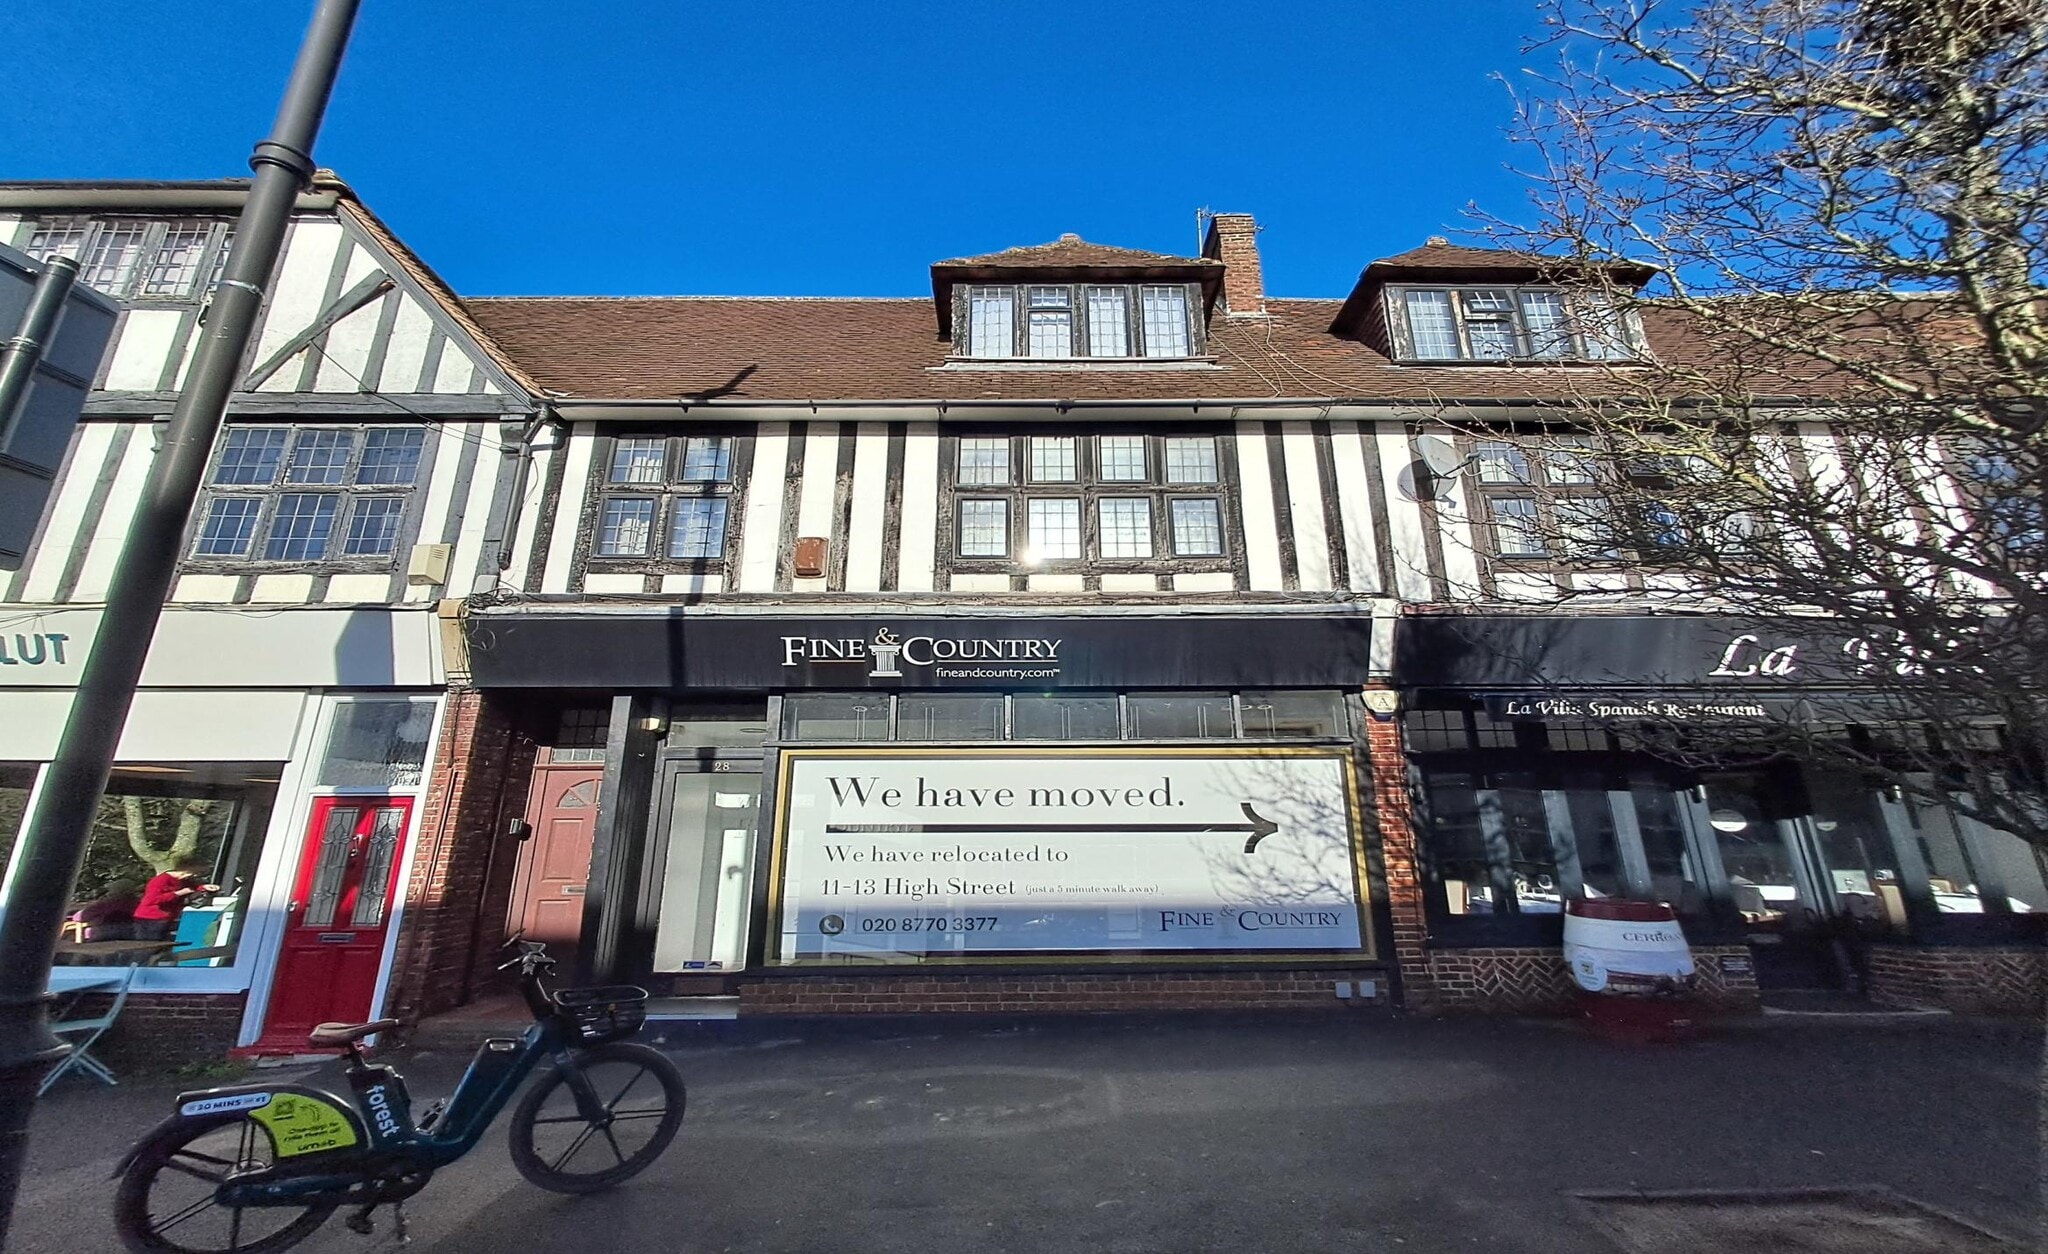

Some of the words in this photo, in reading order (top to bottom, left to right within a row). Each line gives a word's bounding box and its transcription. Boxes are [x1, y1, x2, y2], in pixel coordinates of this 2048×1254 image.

[780, 636, 866, 666] FINE
[874, 627, 899, 645] &
[902, 636, 1062, 666] COUNTRY
[1708, 634, 1798, 676] La
[1506, 701, 1531, 715] La
[714, 762, 730, 772] 28
[825, 776, 902, 808] We
[914, 776, 1015, 808] have
[1027, 776, 1186, 808] moved.
[824, 844, 865, 863] We
[871, 844, 925, 863] have
[931, 844, 1041, 863] relocated
[1046, 846, 1070, 863] to
[821, 878, 877, 896] 11-13
[883, 877, 940, 902] High
[946, 877, 1017, 896] Street
[1025, 883, 1047, 896] (just
[1065, 884, 1101, 893] minute
[1102, 884, 1127, 893] walk
[1128, 884, 1159, 896] away)
[861, 917, 897, 932] 020
[901, 917, 948, 932] 8770
[952, 916, 999, 932] 3377
[1158, 910, 1214, 932] FINE
[1237, 909, 1342, 931] COUNTRY
[213, 1099, 241, 1109] MINS
[366, 1085, 400, 1138] forest
